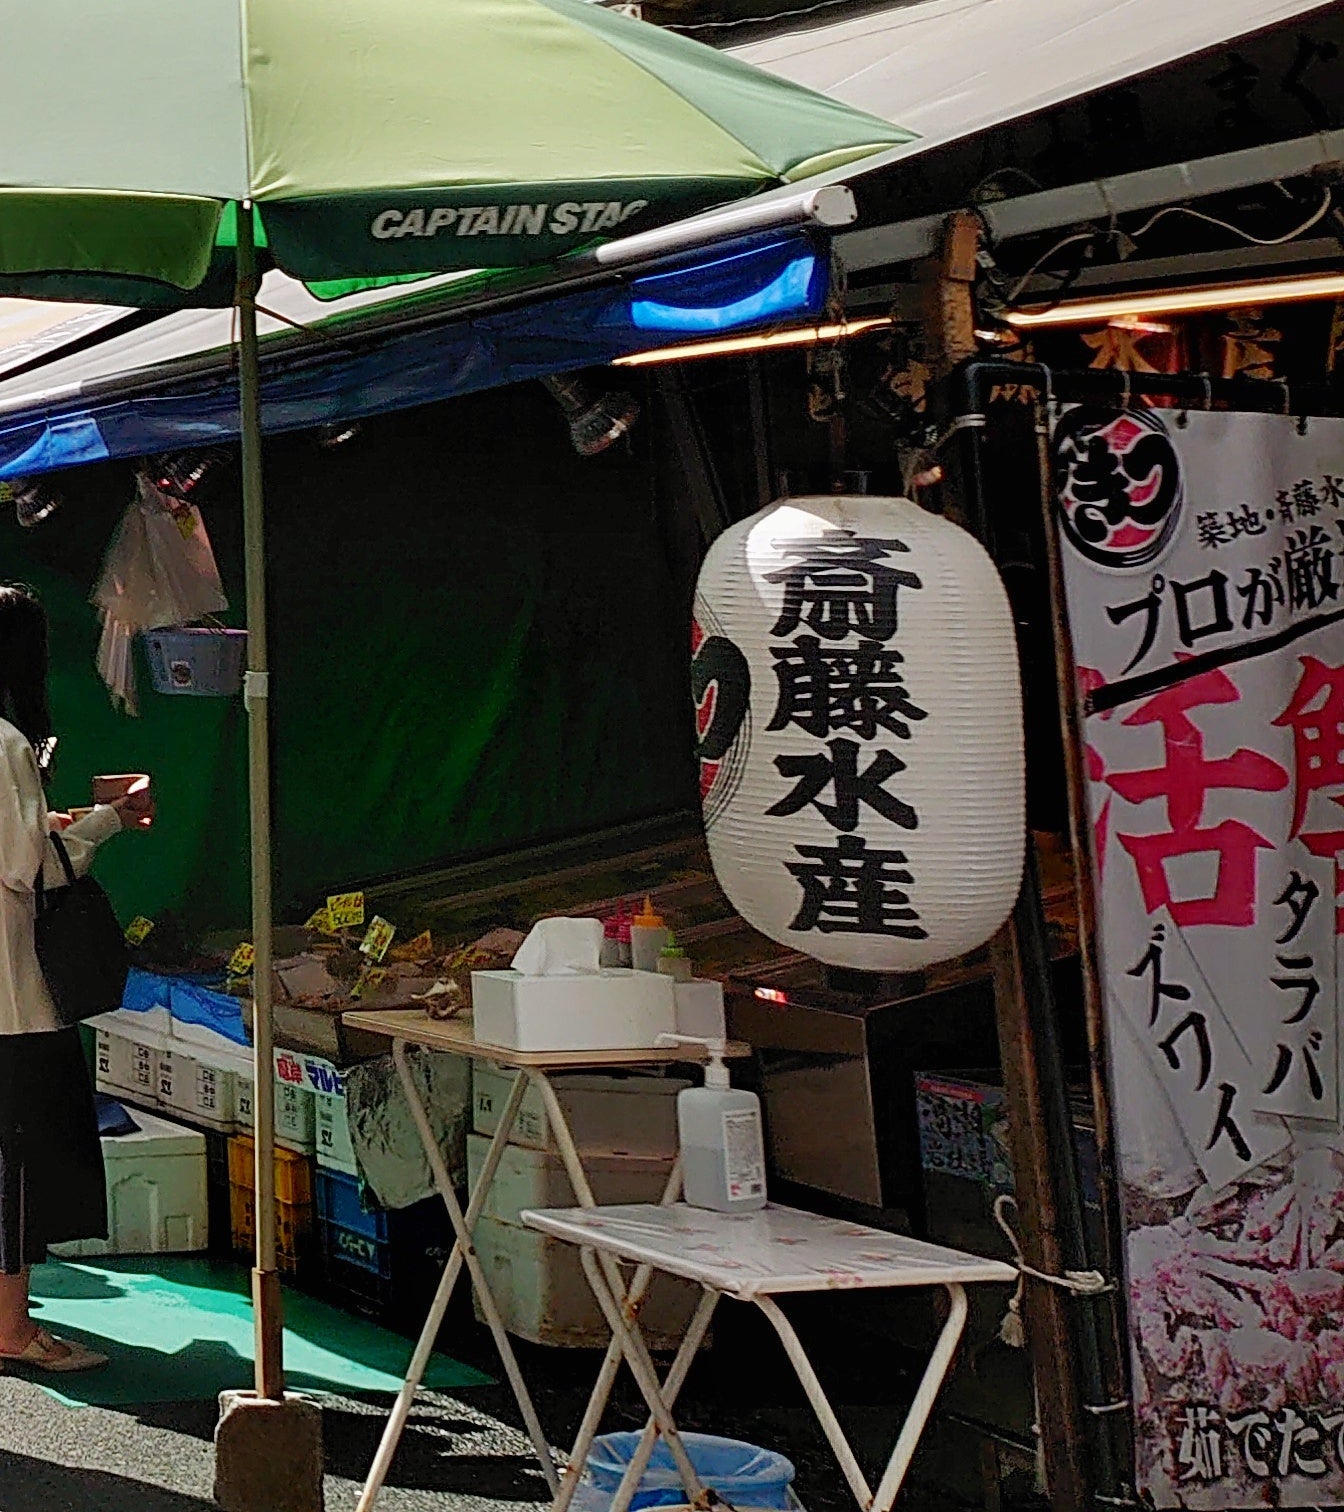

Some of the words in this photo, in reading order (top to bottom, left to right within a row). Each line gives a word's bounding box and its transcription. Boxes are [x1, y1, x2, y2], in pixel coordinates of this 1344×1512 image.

[372, 202, 549, 240] CAPTAIN
[1105, 518, 1344, 677] プロが厳
[1126, 921, 1253, 1163] ズワイ
[1263, 870, 1322, 1100] タラバ
